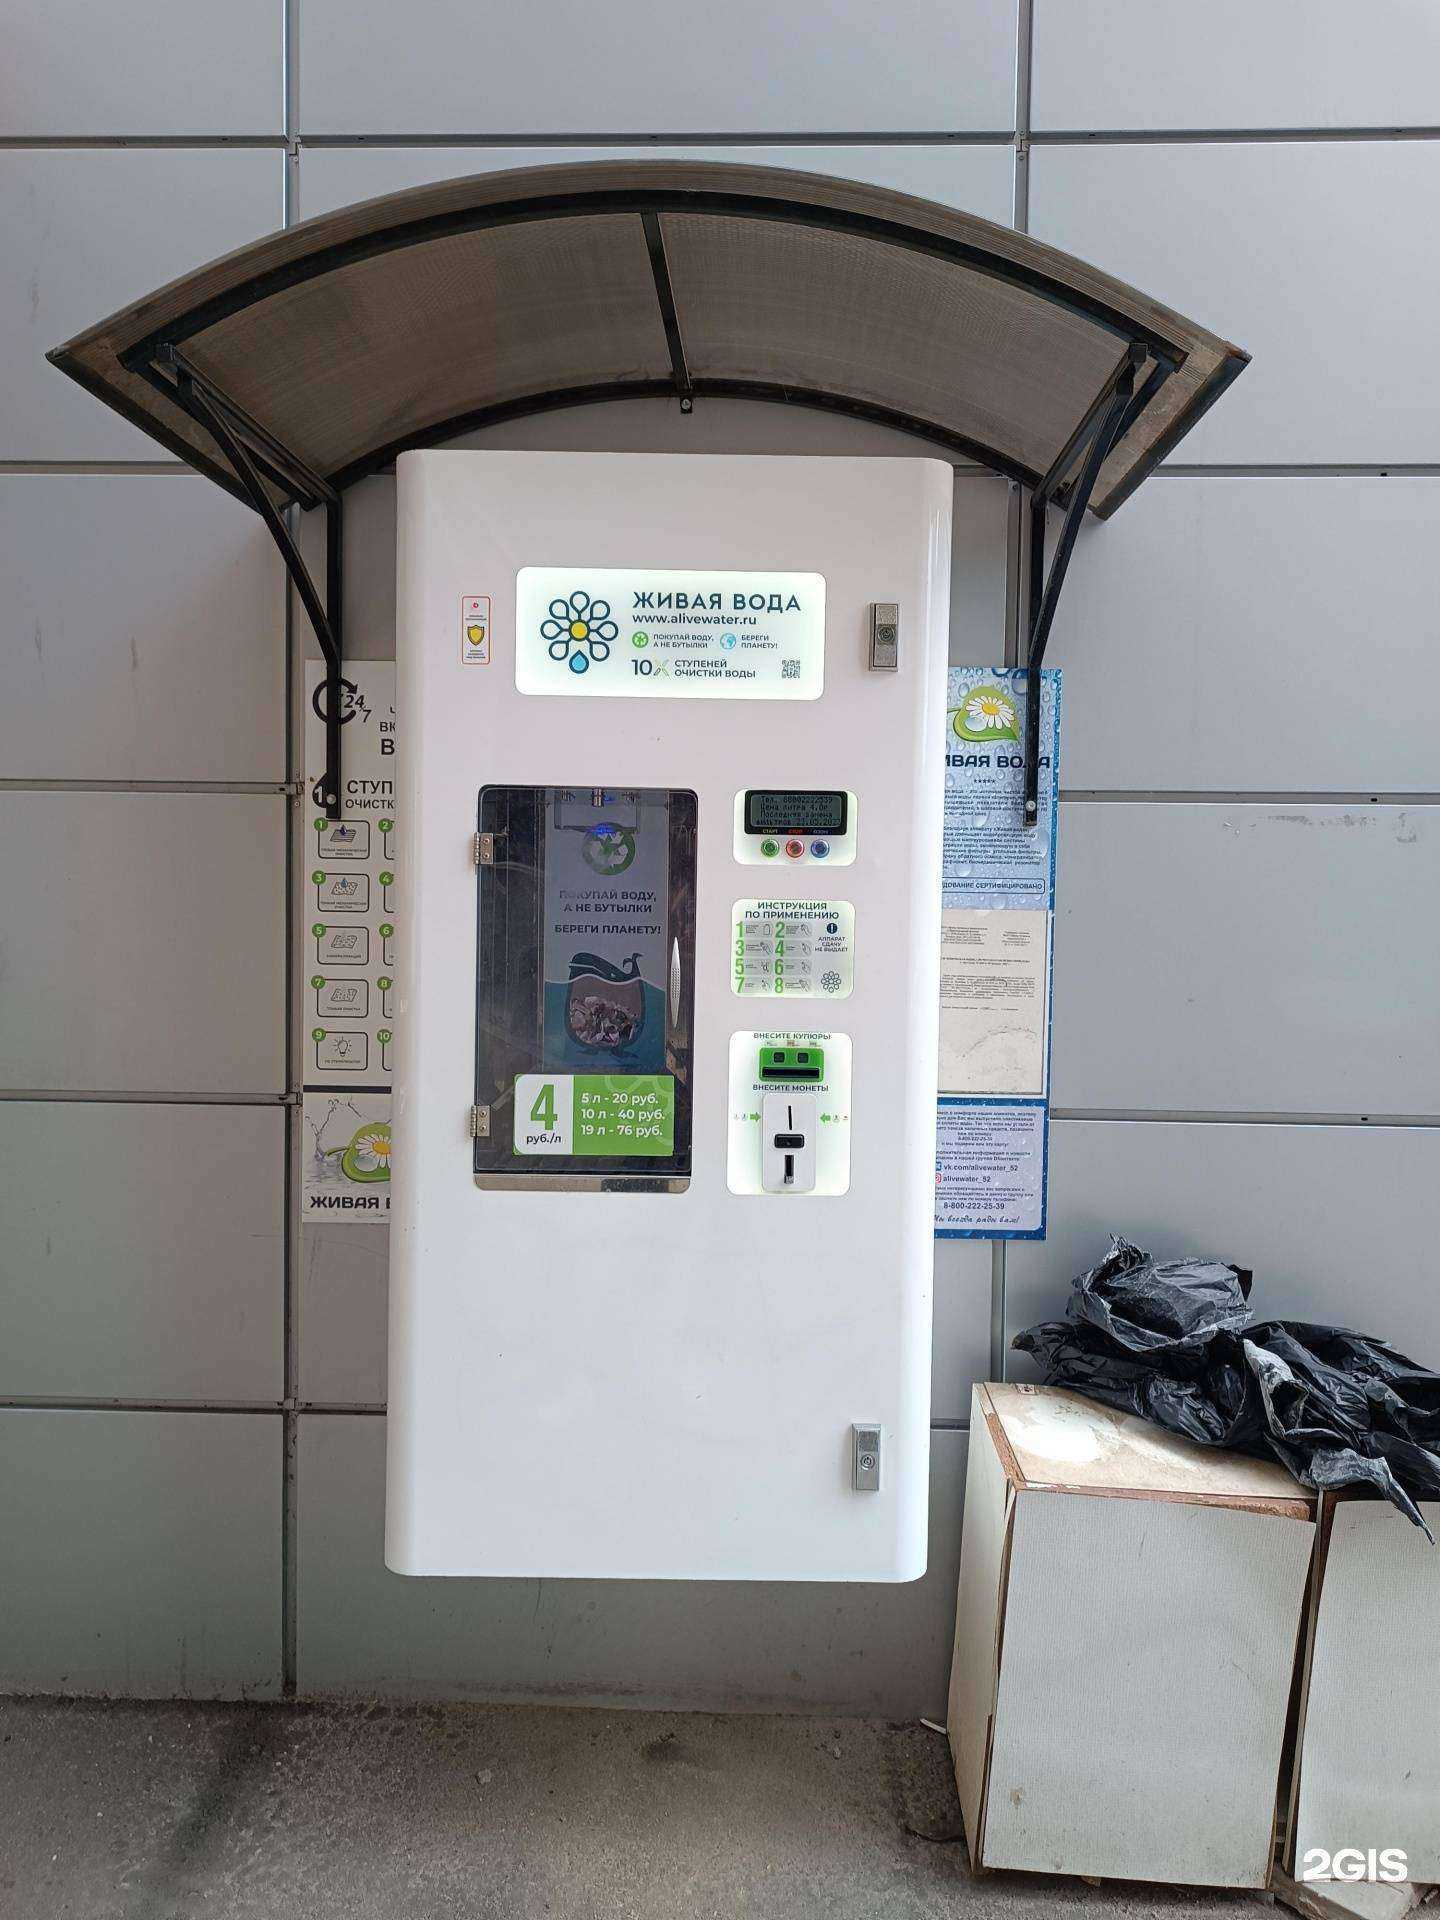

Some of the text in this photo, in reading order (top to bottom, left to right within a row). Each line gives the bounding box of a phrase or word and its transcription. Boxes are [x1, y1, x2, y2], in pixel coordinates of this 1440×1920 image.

[633, 592, 802, 613] ЖИВАЯ ВОДА
[632, 613, 757, 626] www.alivewater.ru
[653, 632, 689, 641] ПОКУПАЙ
[672, 641, 708, 649] БУТЫЛКИ
[741, 641, 778, 649] ПЛАНЕТУ!
[674, 657, 727, 668] СТУПЕНЕЙ
[674, 668, 756, 678] ОЧИСТКИ ВОДЫ
[997, 755, 1050, 768] ВОА
[621, 890, 657, 902] ВОДУ,
[576, 903, 592, 912] НЕ
[595, 903, 652, 913] БУТЫЛКИ
[757, 902, 827, 911] ИНСТРУКЦИЯ
[745, 910, 840, 919] ПО ПРИМЕНЕНИЮ
[555, 924, 661, 935] БЕРЕГИ ПЛАНЕТУ!
[735, 921, 744, 938] 1
[775, 921, 785, 939] 2
[736, 939, 744, 956] 3
[775, 940, 784, 957] 4
[735, 958, 744, 975] 5
[774, 958, 784, 976] 6
[735, 976, 744, 993] 7
[774, 977, 784, 993] 8
[793, 1032, 831, 1040] КУПЮРЫ
[792, 1084, 829, 1092] МОНЕТЫ
[581, 1092, 589, 1104] 5
[592, 1094, 600, 1104] л
[612, 1093, 628, 1104] 20
[631, 1092, 659, 1106] руб.
[531, 1084, 558, 1131] 4
[581, 1108, 594, 1119] 10
[597, 1110, 606, 1119] л
[617, 1109, 635, 1120] 40
[638, 1108, 665, 1121] руб.
[581, 1124, 594, 1135] 19
[596, 1126, 605, 1135] л
[617, 1125, 633, 1135] 76
[636, 1124, 663, 1137] руб.
[526, 1132, 562, 1145] руб./л
[943, 1164, 1019, 1173] vk.com/alivewater_52
[943, 1175, 991, 1184] alivewater_52
[310, 1196, 379, 1209] ЖИВАЯ
[943, 1202, 1005, 1210] 8-800-222-25-39
